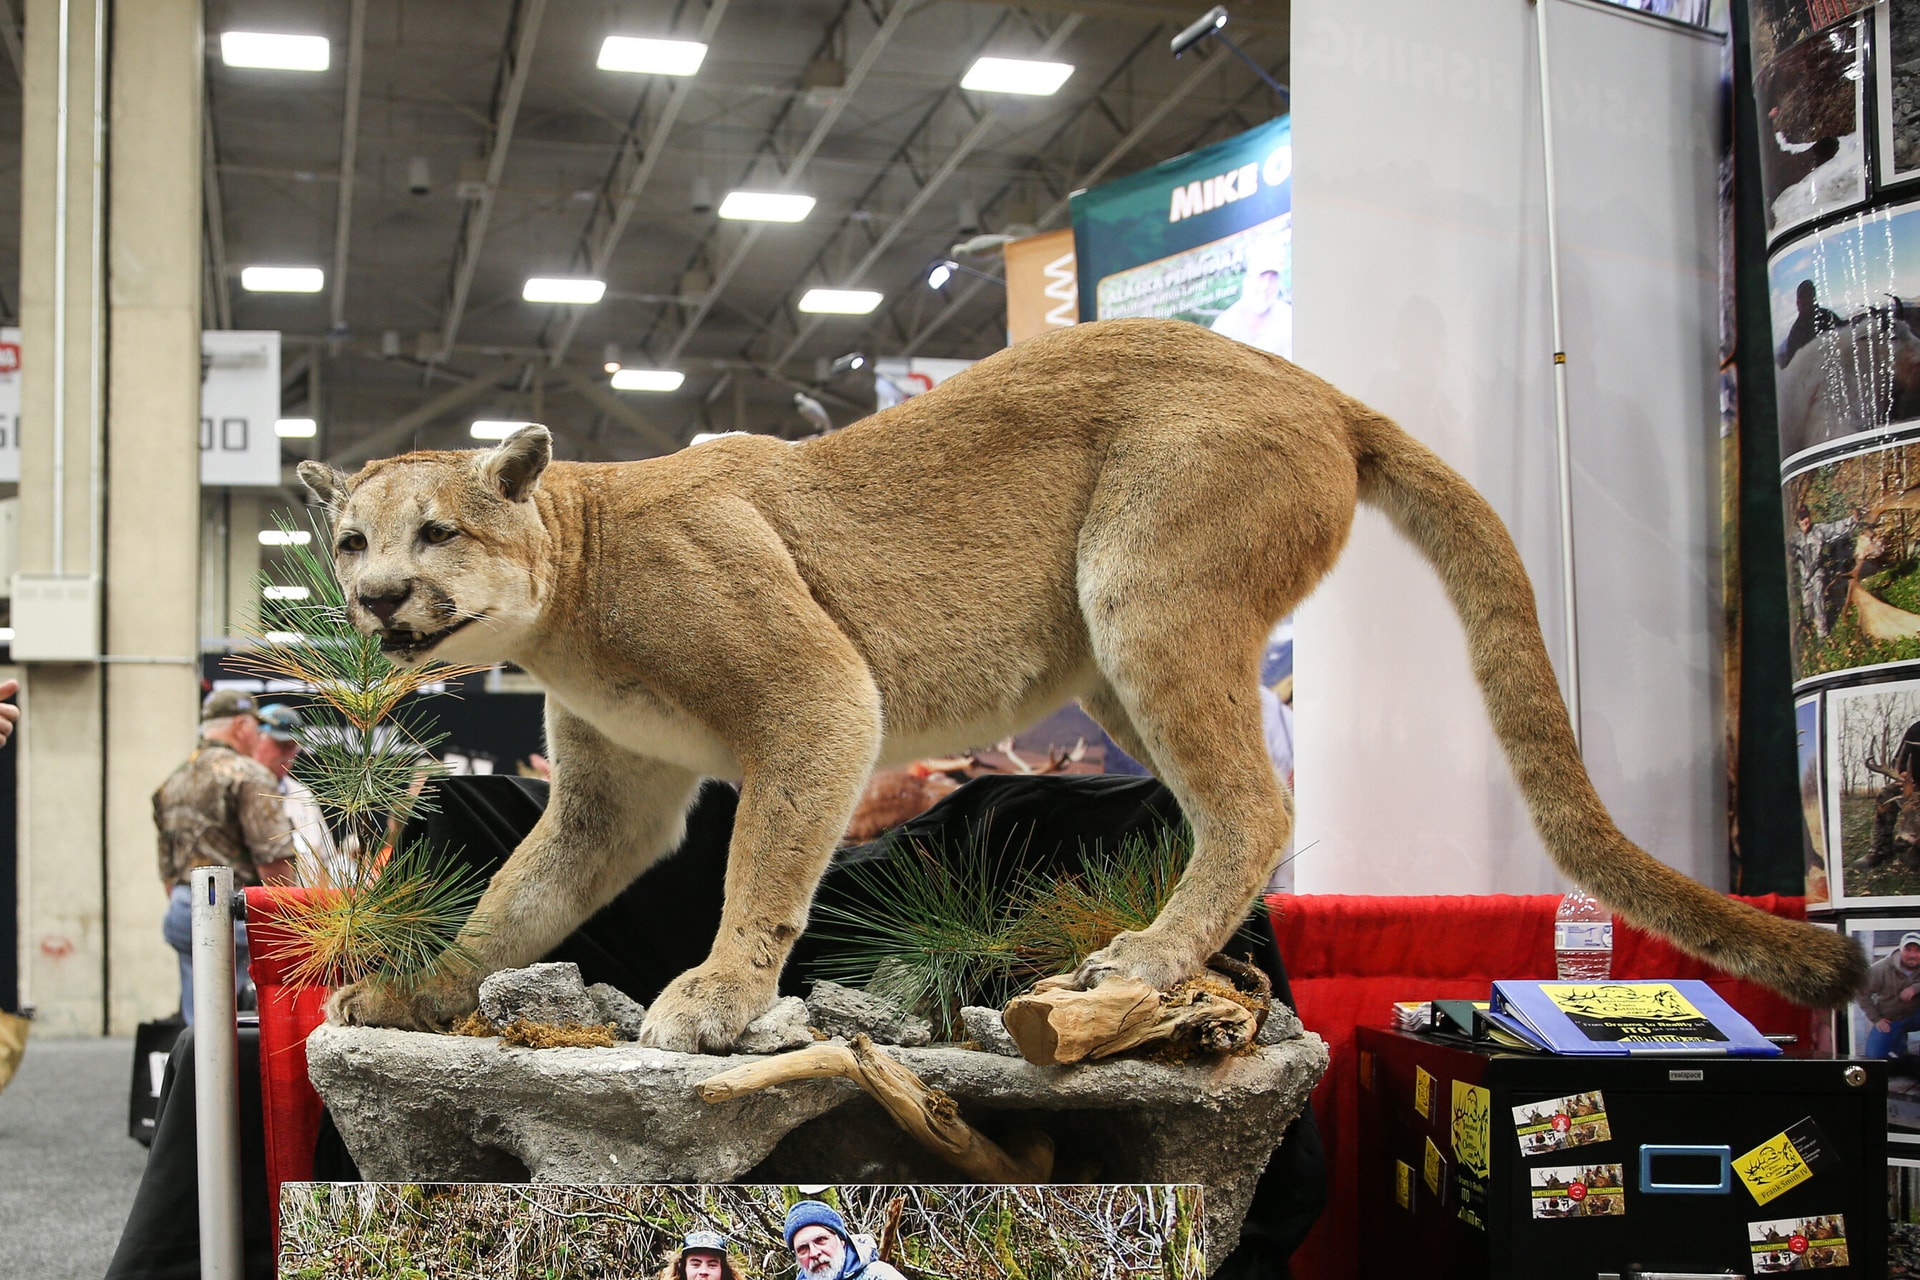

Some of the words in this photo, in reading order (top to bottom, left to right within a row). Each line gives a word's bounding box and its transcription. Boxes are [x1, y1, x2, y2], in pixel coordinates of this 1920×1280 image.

[1169, 161, 1258, 223] MIKE
[1621, 1026, 1652, 1034] ITO
[1761, 1185, 1781, 1198] Frank
[1781, 1174, 1800, 1187] Smith
[1800, 1167, 1808, 1176] IV
